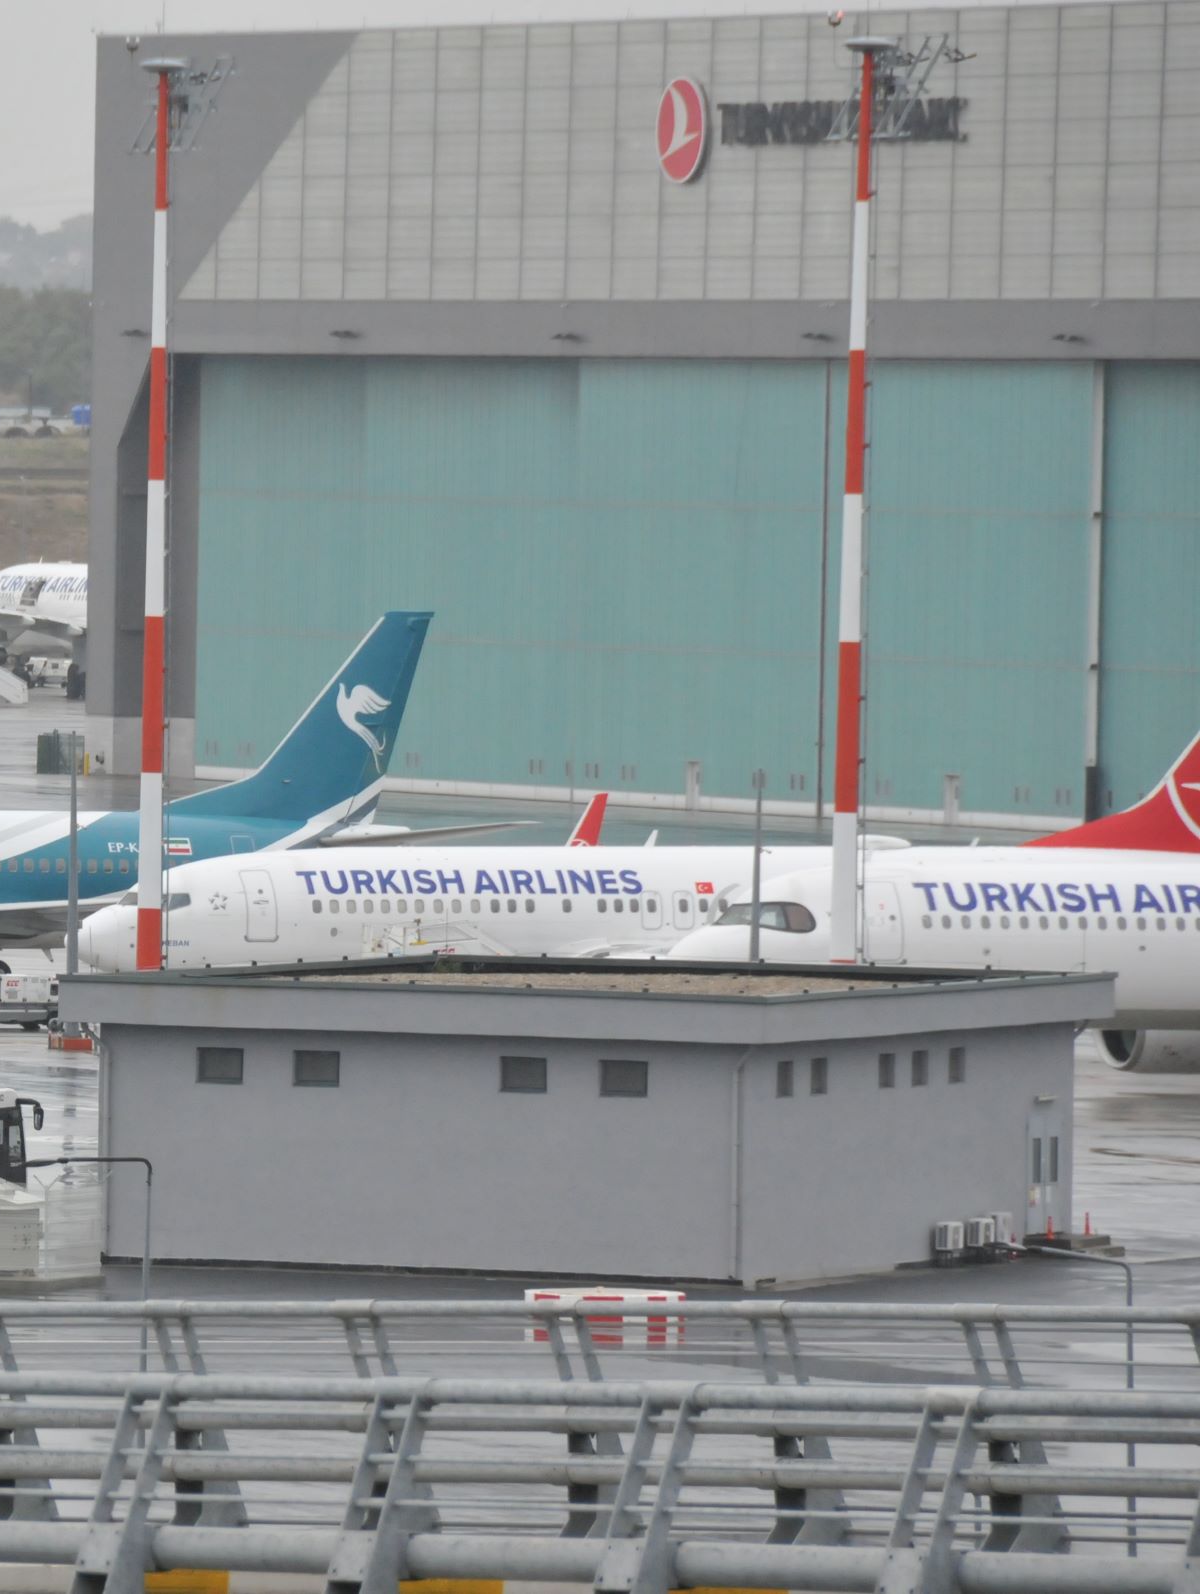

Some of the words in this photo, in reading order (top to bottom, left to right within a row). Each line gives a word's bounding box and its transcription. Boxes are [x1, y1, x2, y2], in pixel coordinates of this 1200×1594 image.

[296, 870, 465, 895] TURKISH
[474, 870, 643, 895] AIRLINES
[912, 882, 1121, 913] TURKISH
[1133, 884, 1200, 913] AIR
